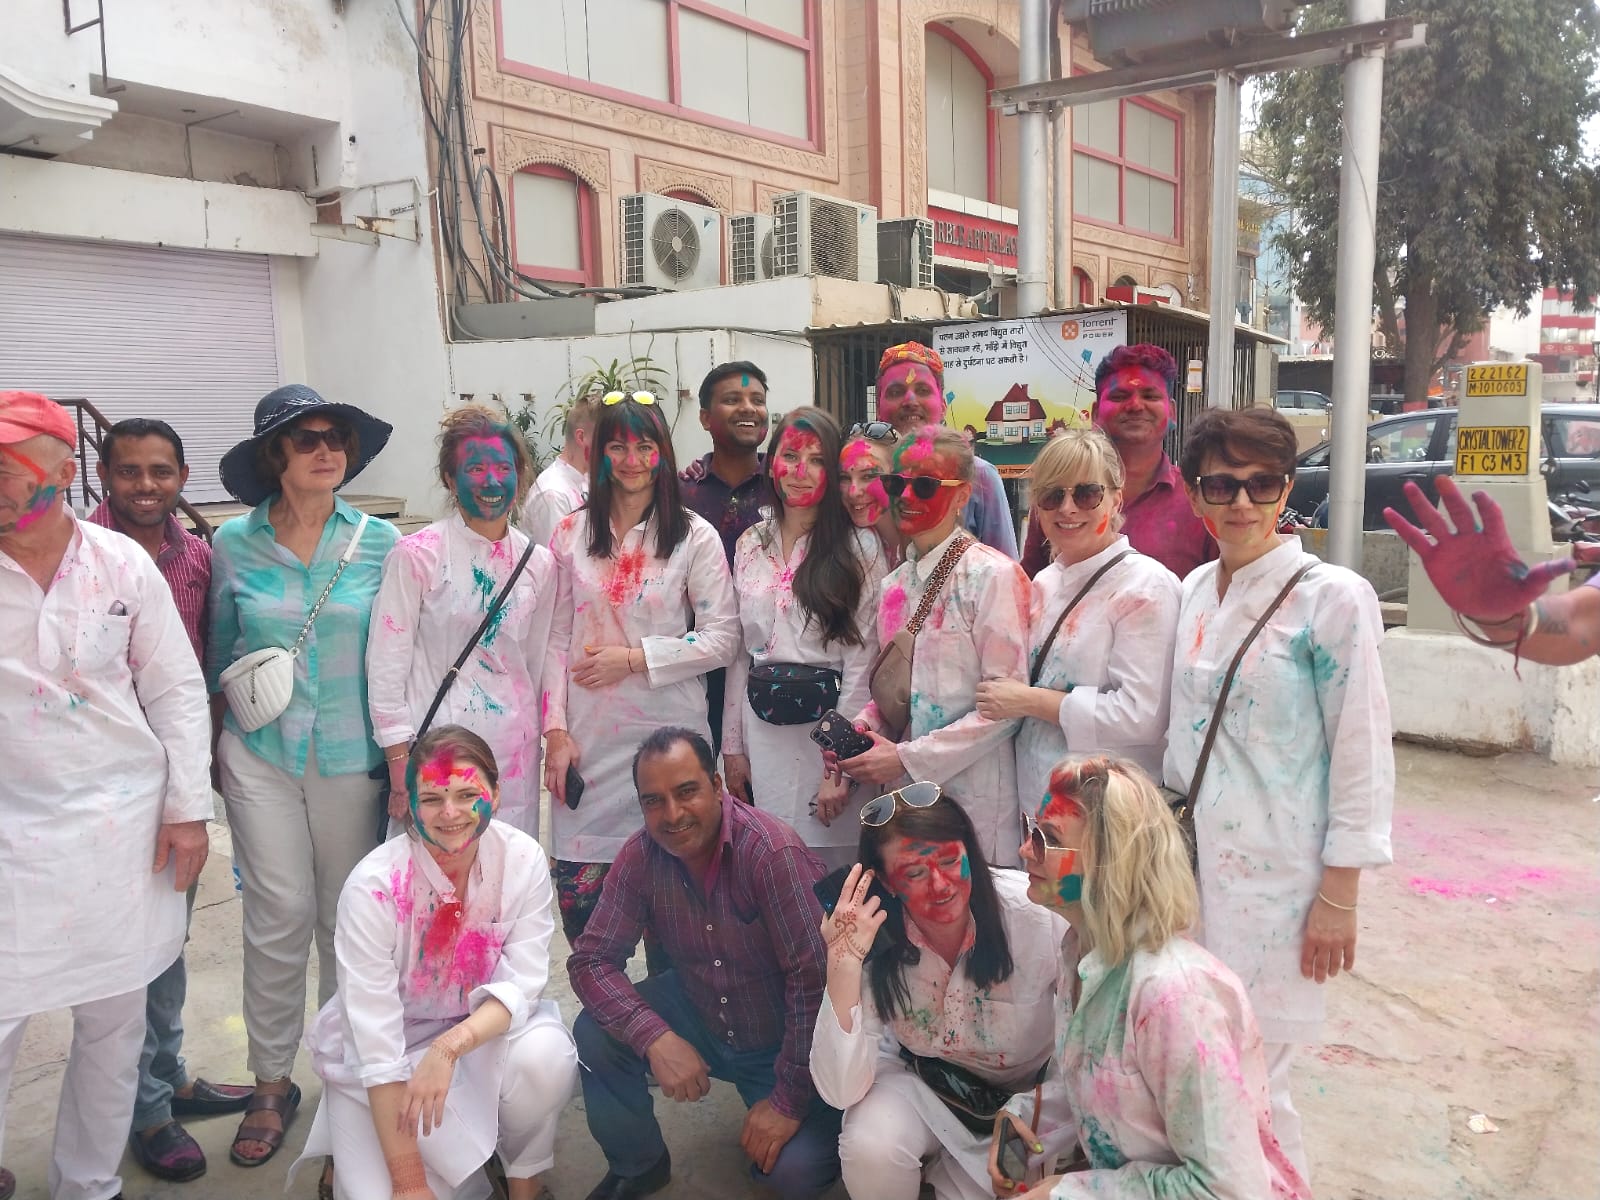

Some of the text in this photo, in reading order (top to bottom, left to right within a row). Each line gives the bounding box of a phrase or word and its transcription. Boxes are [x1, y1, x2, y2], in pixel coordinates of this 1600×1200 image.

[1080, 317, 1118, 328] torrent
[1460, 429, 1489, 451] CRYSTAL
[1461, 454, 1474, 472] F1
[1481, 454, 1497, 472] C3
